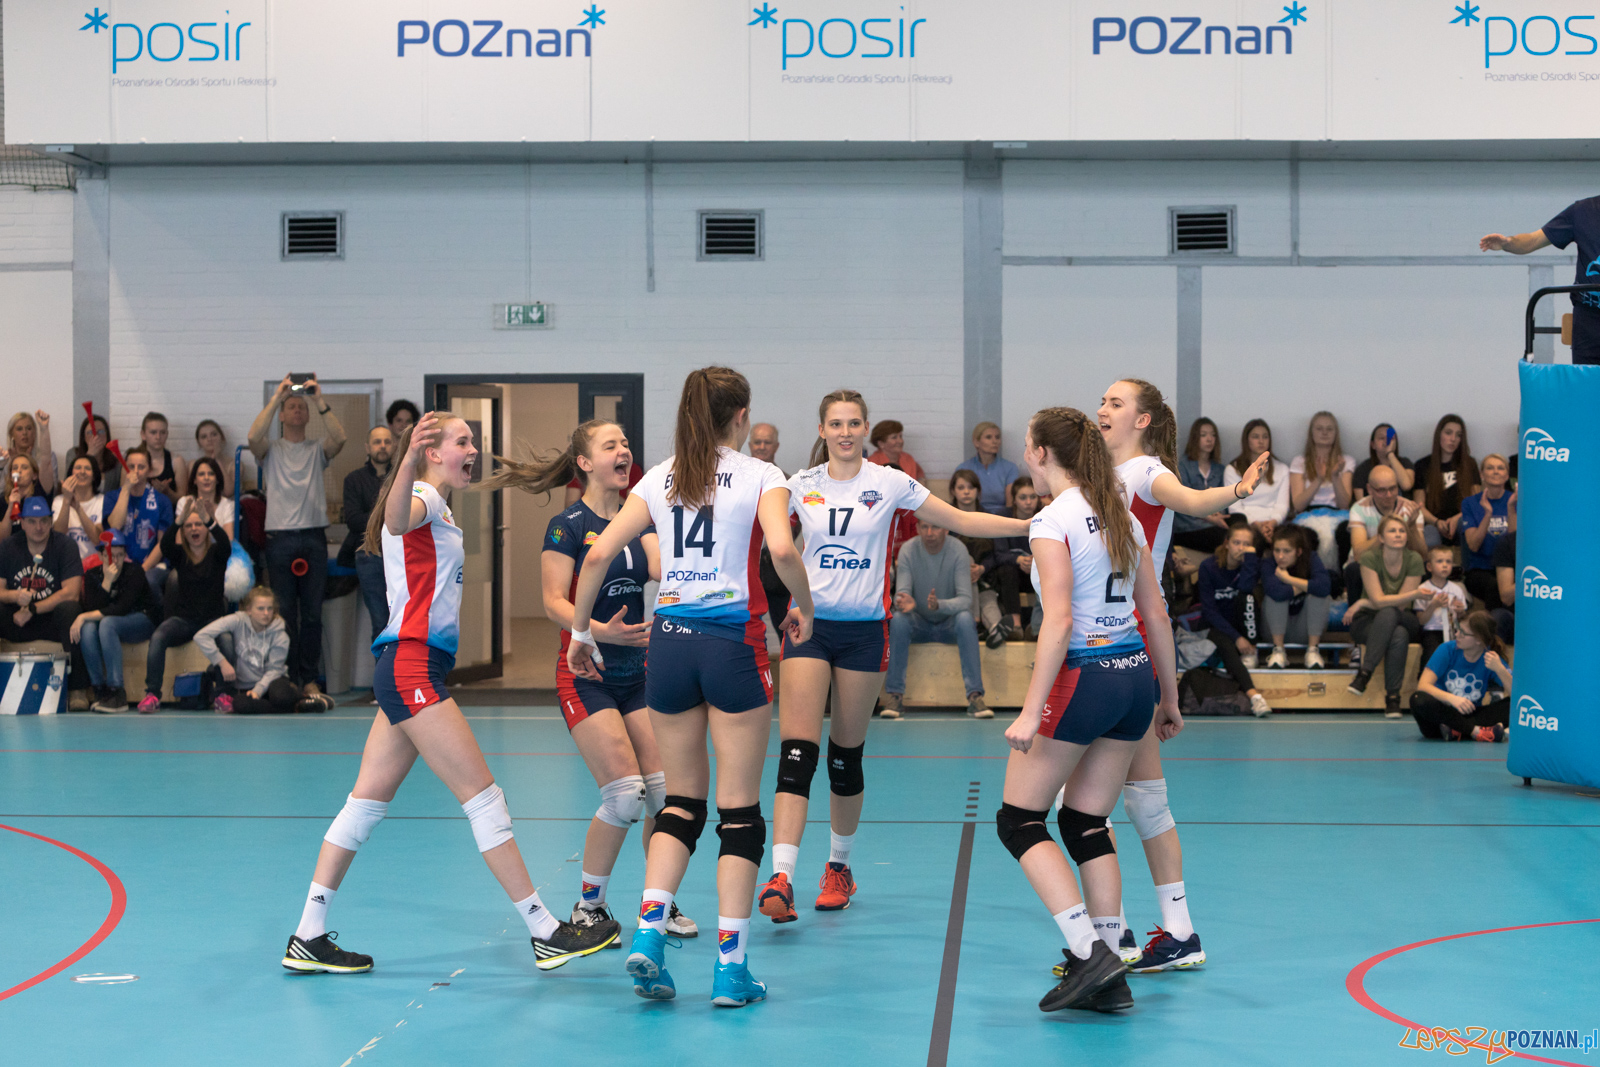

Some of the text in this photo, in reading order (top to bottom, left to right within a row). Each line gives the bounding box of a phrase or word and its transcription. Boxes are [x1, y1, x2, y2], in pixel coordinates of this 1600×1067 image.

[112, 10, 252, 75] posir
[782, 6, 927, 71] posir
[201, 77, 231, 88] Sportu
[237, 77, 277, 87] Rekreacji
[875, 74, 906, 84] Sportu
[912, 74, 953, 85] Rekreacji
[1525, 440, 1570, 462] Enea
[671, 505, 716, 558] 14
[828, 507, 855, 537] 17
[623, 545, 634, 570] 1
[819, 553, 872, 570] Enea
[607, 584, 642, 597] Enea
[1523, 578, 1563, 600] Enea
[1243, 594, 1257, 639] adidas
[414, 688, 427, 704] 4
[566, 700, 575, 715] 1
[1518, 706, 1559, 731] Enea
